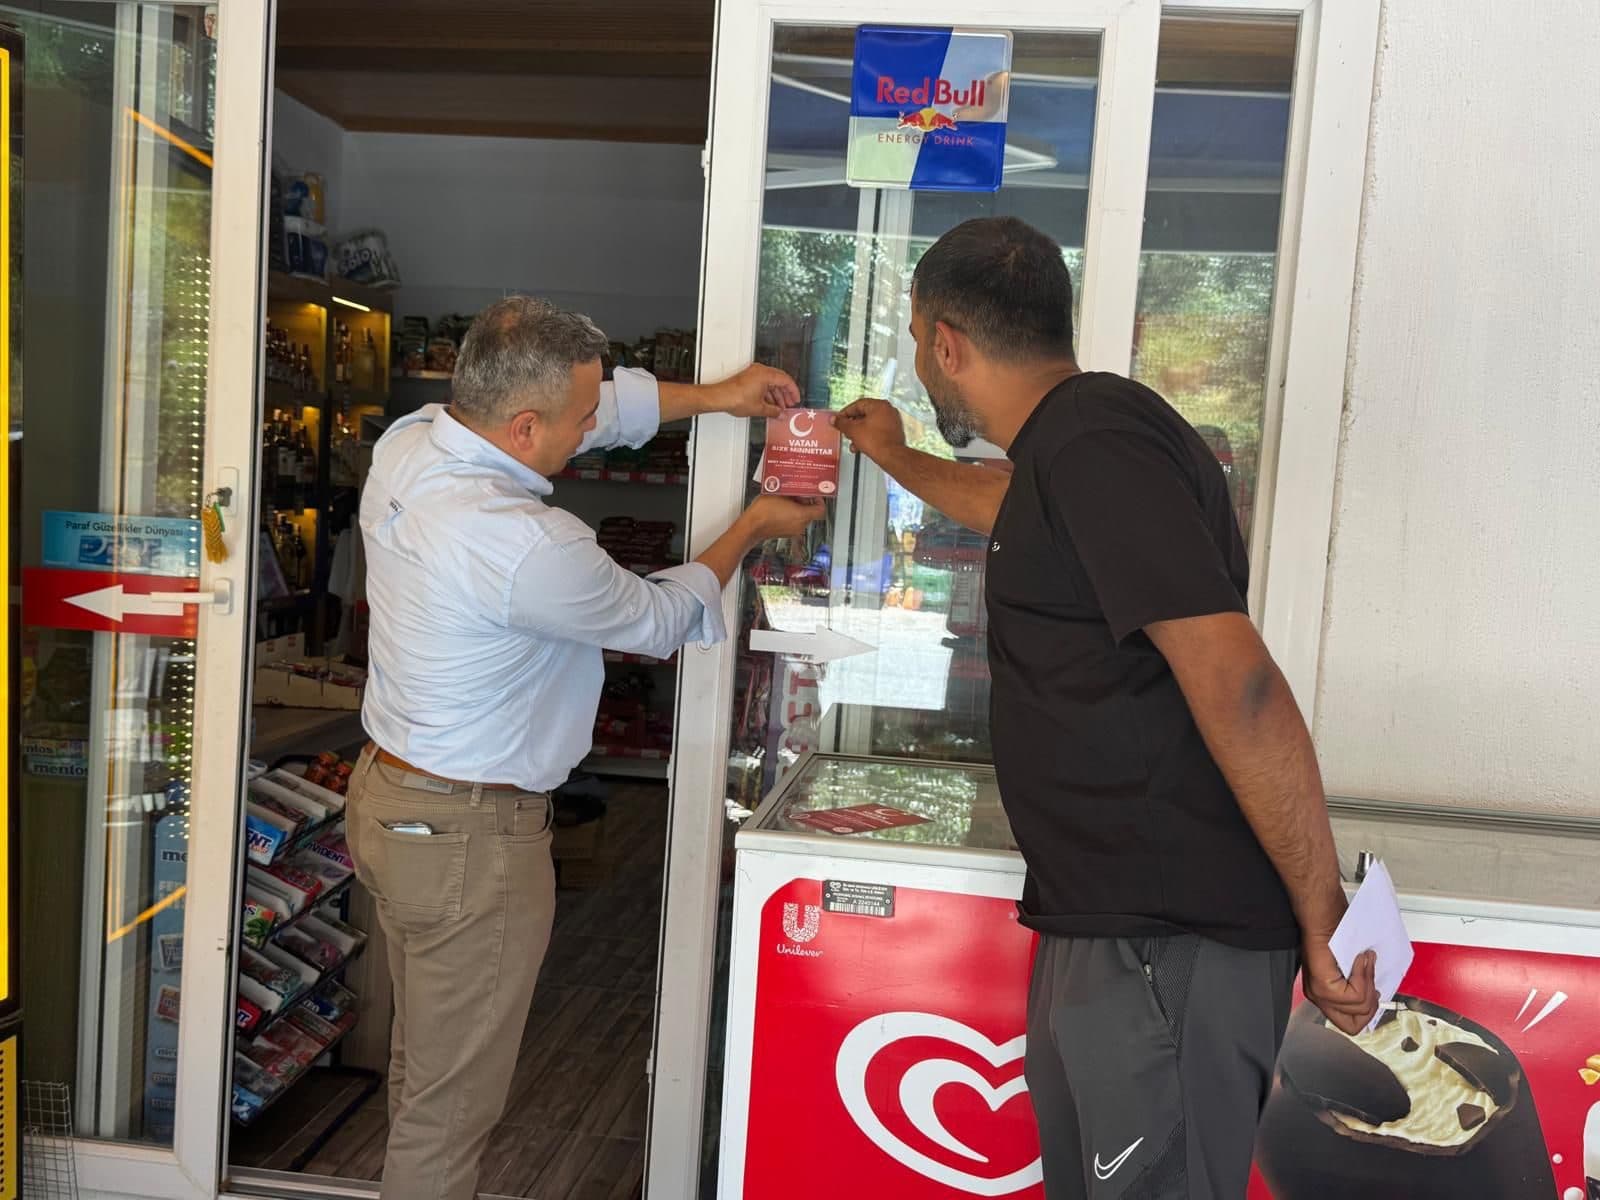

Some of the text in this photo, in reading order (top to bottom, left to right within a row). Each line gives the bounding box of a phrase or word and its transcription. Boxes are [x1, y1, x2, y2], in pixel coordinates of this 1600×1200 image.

[877, 75, 985, 107] Red Bull
[878, 133, 973, 147] ENERGY DRINK
[789, 439, 818, 448] VATAN
[65, 520, 90, 530] Paraf
[777, 943, 824, 957] Unilever
